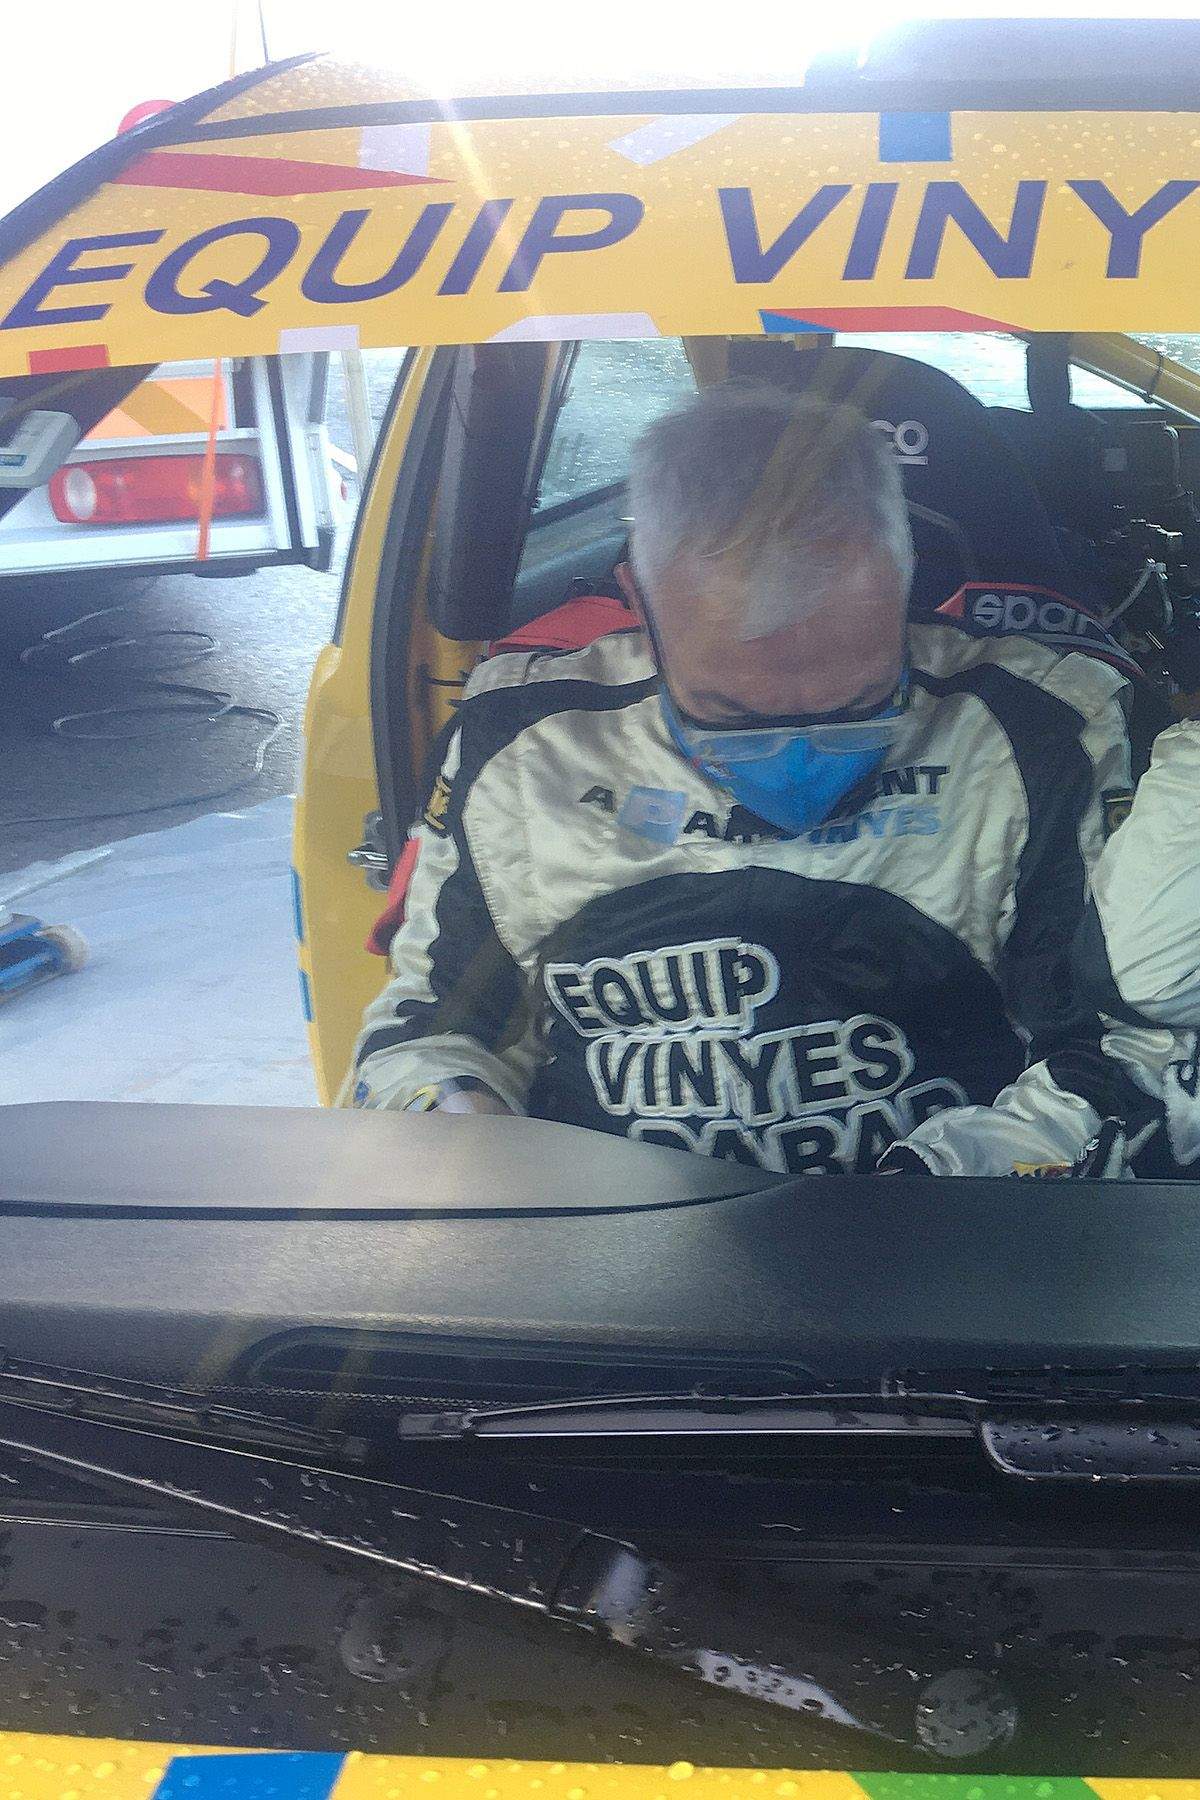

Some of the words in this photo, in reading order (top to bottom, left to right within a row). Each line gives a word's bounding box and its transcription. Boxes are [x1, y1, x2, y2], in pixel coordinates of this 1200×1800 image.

[0, 192, 645, 331] EQUIP
[545, 937, 780, 1037] EQUIP
[586, 1013, 914, 1124] VINYES
